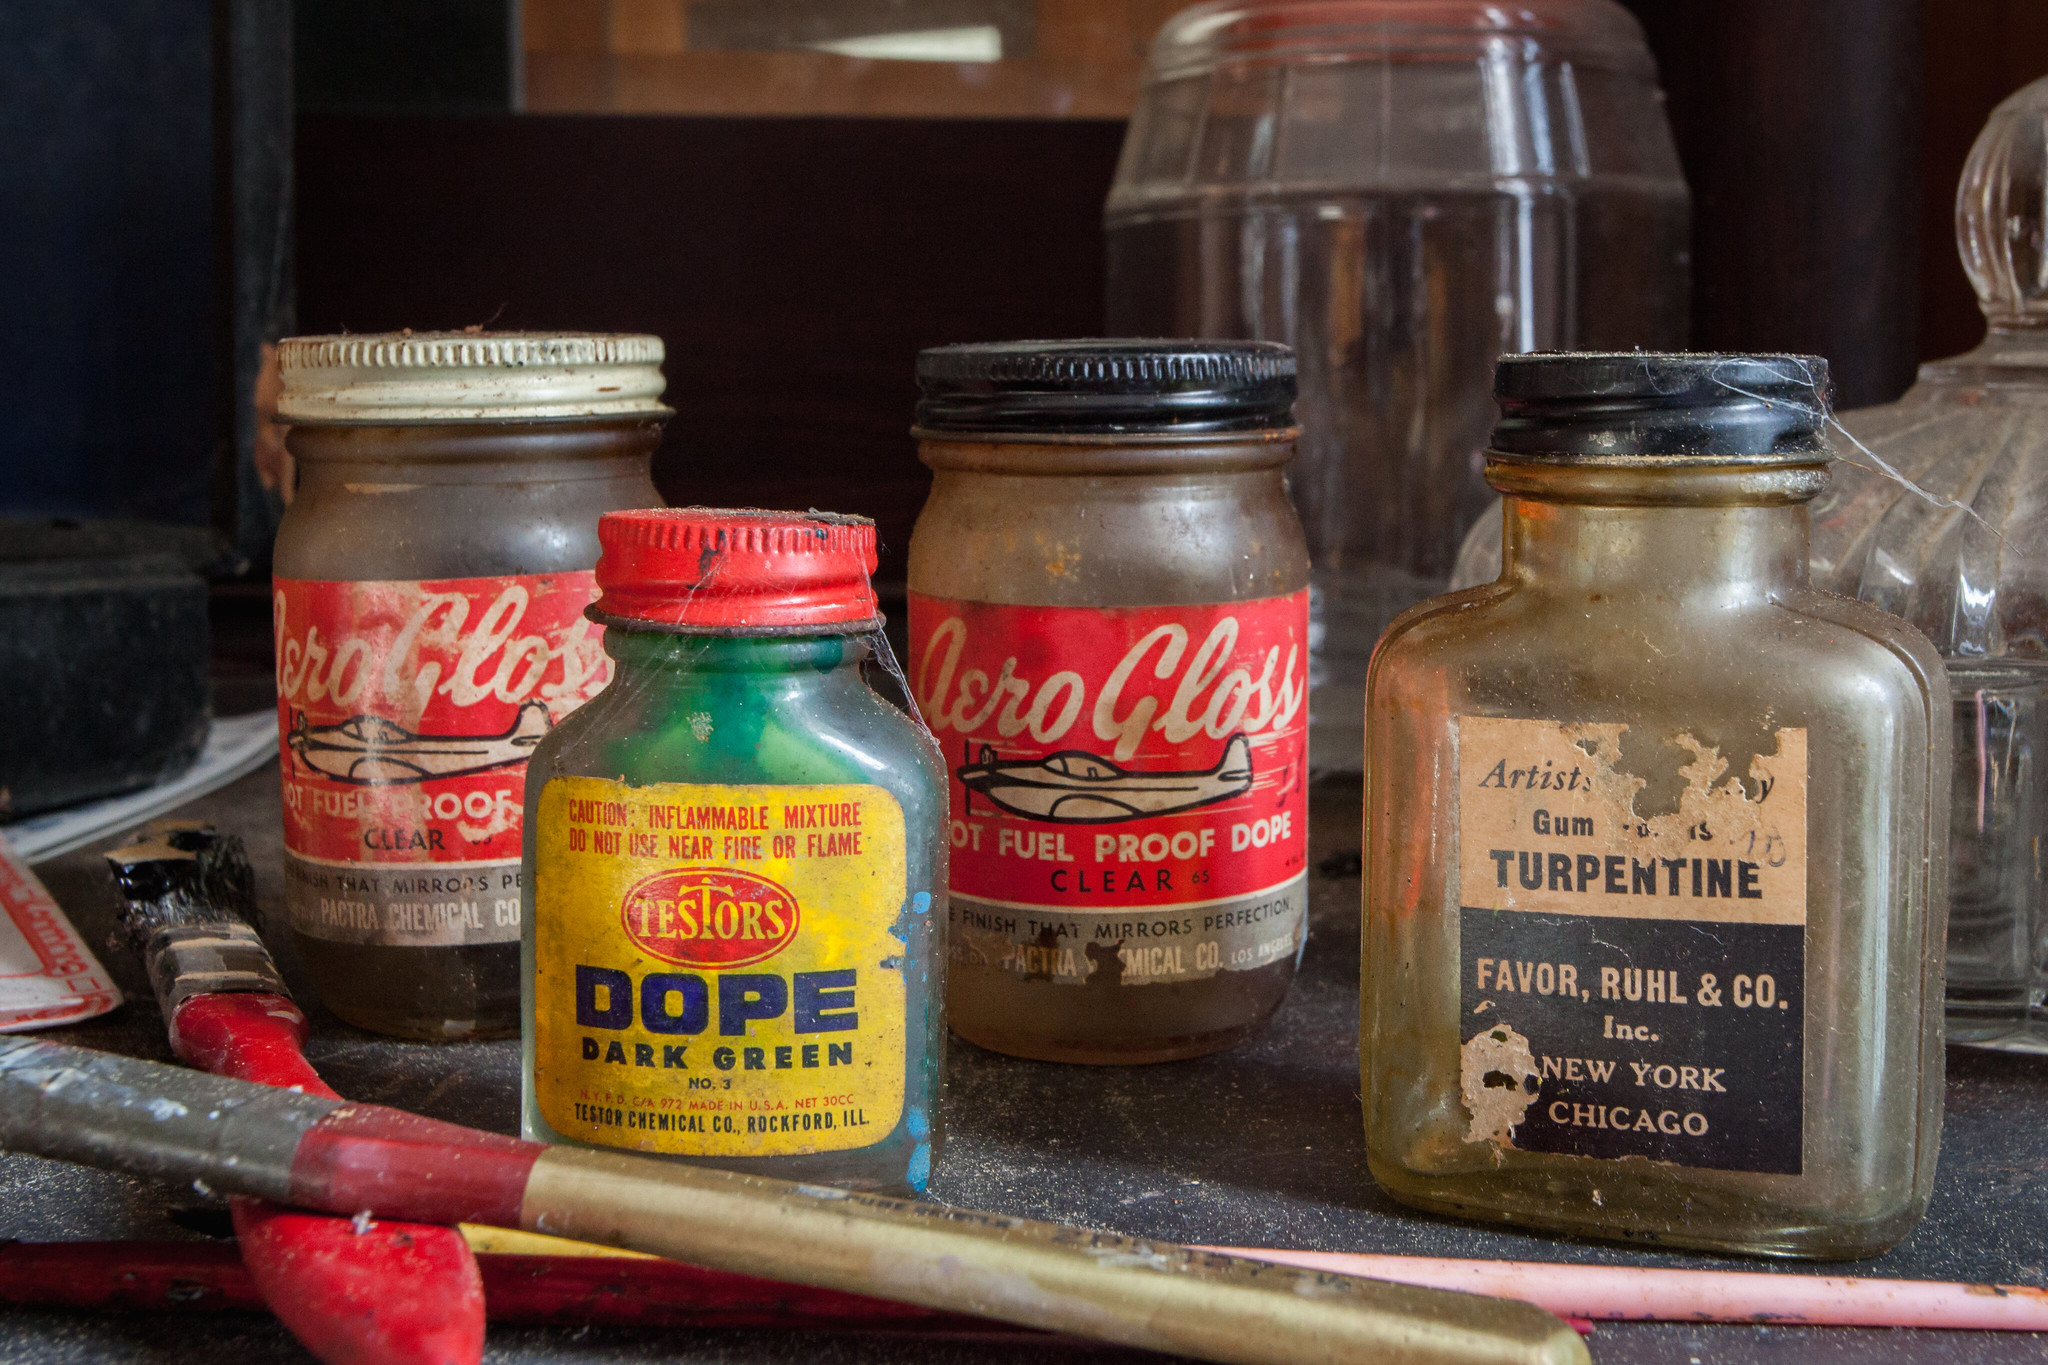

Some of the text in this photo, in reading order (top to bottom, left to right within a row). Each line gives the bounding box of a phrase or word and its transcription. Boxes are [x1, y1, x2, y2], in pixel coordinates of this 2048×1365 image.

[916, 616, 1303, 761] Aero Gloss
[313, 785, 378, 819] FUEL
[392, 789, 512, 820] PROOF
[569, 799, 862, 830] CAUTION: INFLAMMABLE MIXTURE
[999, 828, 1074, 862] FUEL
[1095, 828, 1215, 862] PROOF
[1231, 811, 1292, 852] DOPE
[1532, 809, 1594, 836] Gum
[364, 828, 446, 851] CLEAR
[569, 827, 862, 860] DO NOT USE NEAR FIRE OR FLAME
[336, 876, 380, 893] THAT
[393, 876, 489, 894] MIRRORS
[1051, 869, 1174, 892] CLEAR
[1489, 849, 1763, 899] TURPENTINE
[321, 898, 380, 931] PACTRA
[389, 902, 484, 931] CHEMICAL
[634, 877, 784, 940] TESTORS
[963, 909, 1016, 934] FINISH
[1095, 919, 1193, 939] MIRRORS
[1196, 940, 1223, 970] CO.
[1231, 947, 1253, 965] LOS
[575, 964, 858, 1036] DOPE
[1477, 958, 1789, 1009] FAVOR, RUHL & CO.
[1603, 1015, 1659, 1041] Inc.
[582, 1037, 852, 1070] DARK GREEN
[723, 1079, 731, 1090] 3
[1541, 1056, 1727, 1092] NEW YORK
[575, 1103, 622, 1126] TESTOR
[629, 1111, 705, 1133] CHEMICAL
[747, 1112, 837, 1133] ROCKFORD,
[844, 1109, 869, 1127] ILL.
[632, 1096, 654, 1108] C/A
[661, 1098, 682, 1110] 972
[689, 1100, 723, 1111] MADE
[730, 1101, 743, 1111] IN
[750, 1100, 788, 1111] U.S.A.
[795, 1098, 817, 1109] NET
[823, 1094, 854, 1107] 30CC
[1548, 1101, 1709, 1136] CHICAGO
